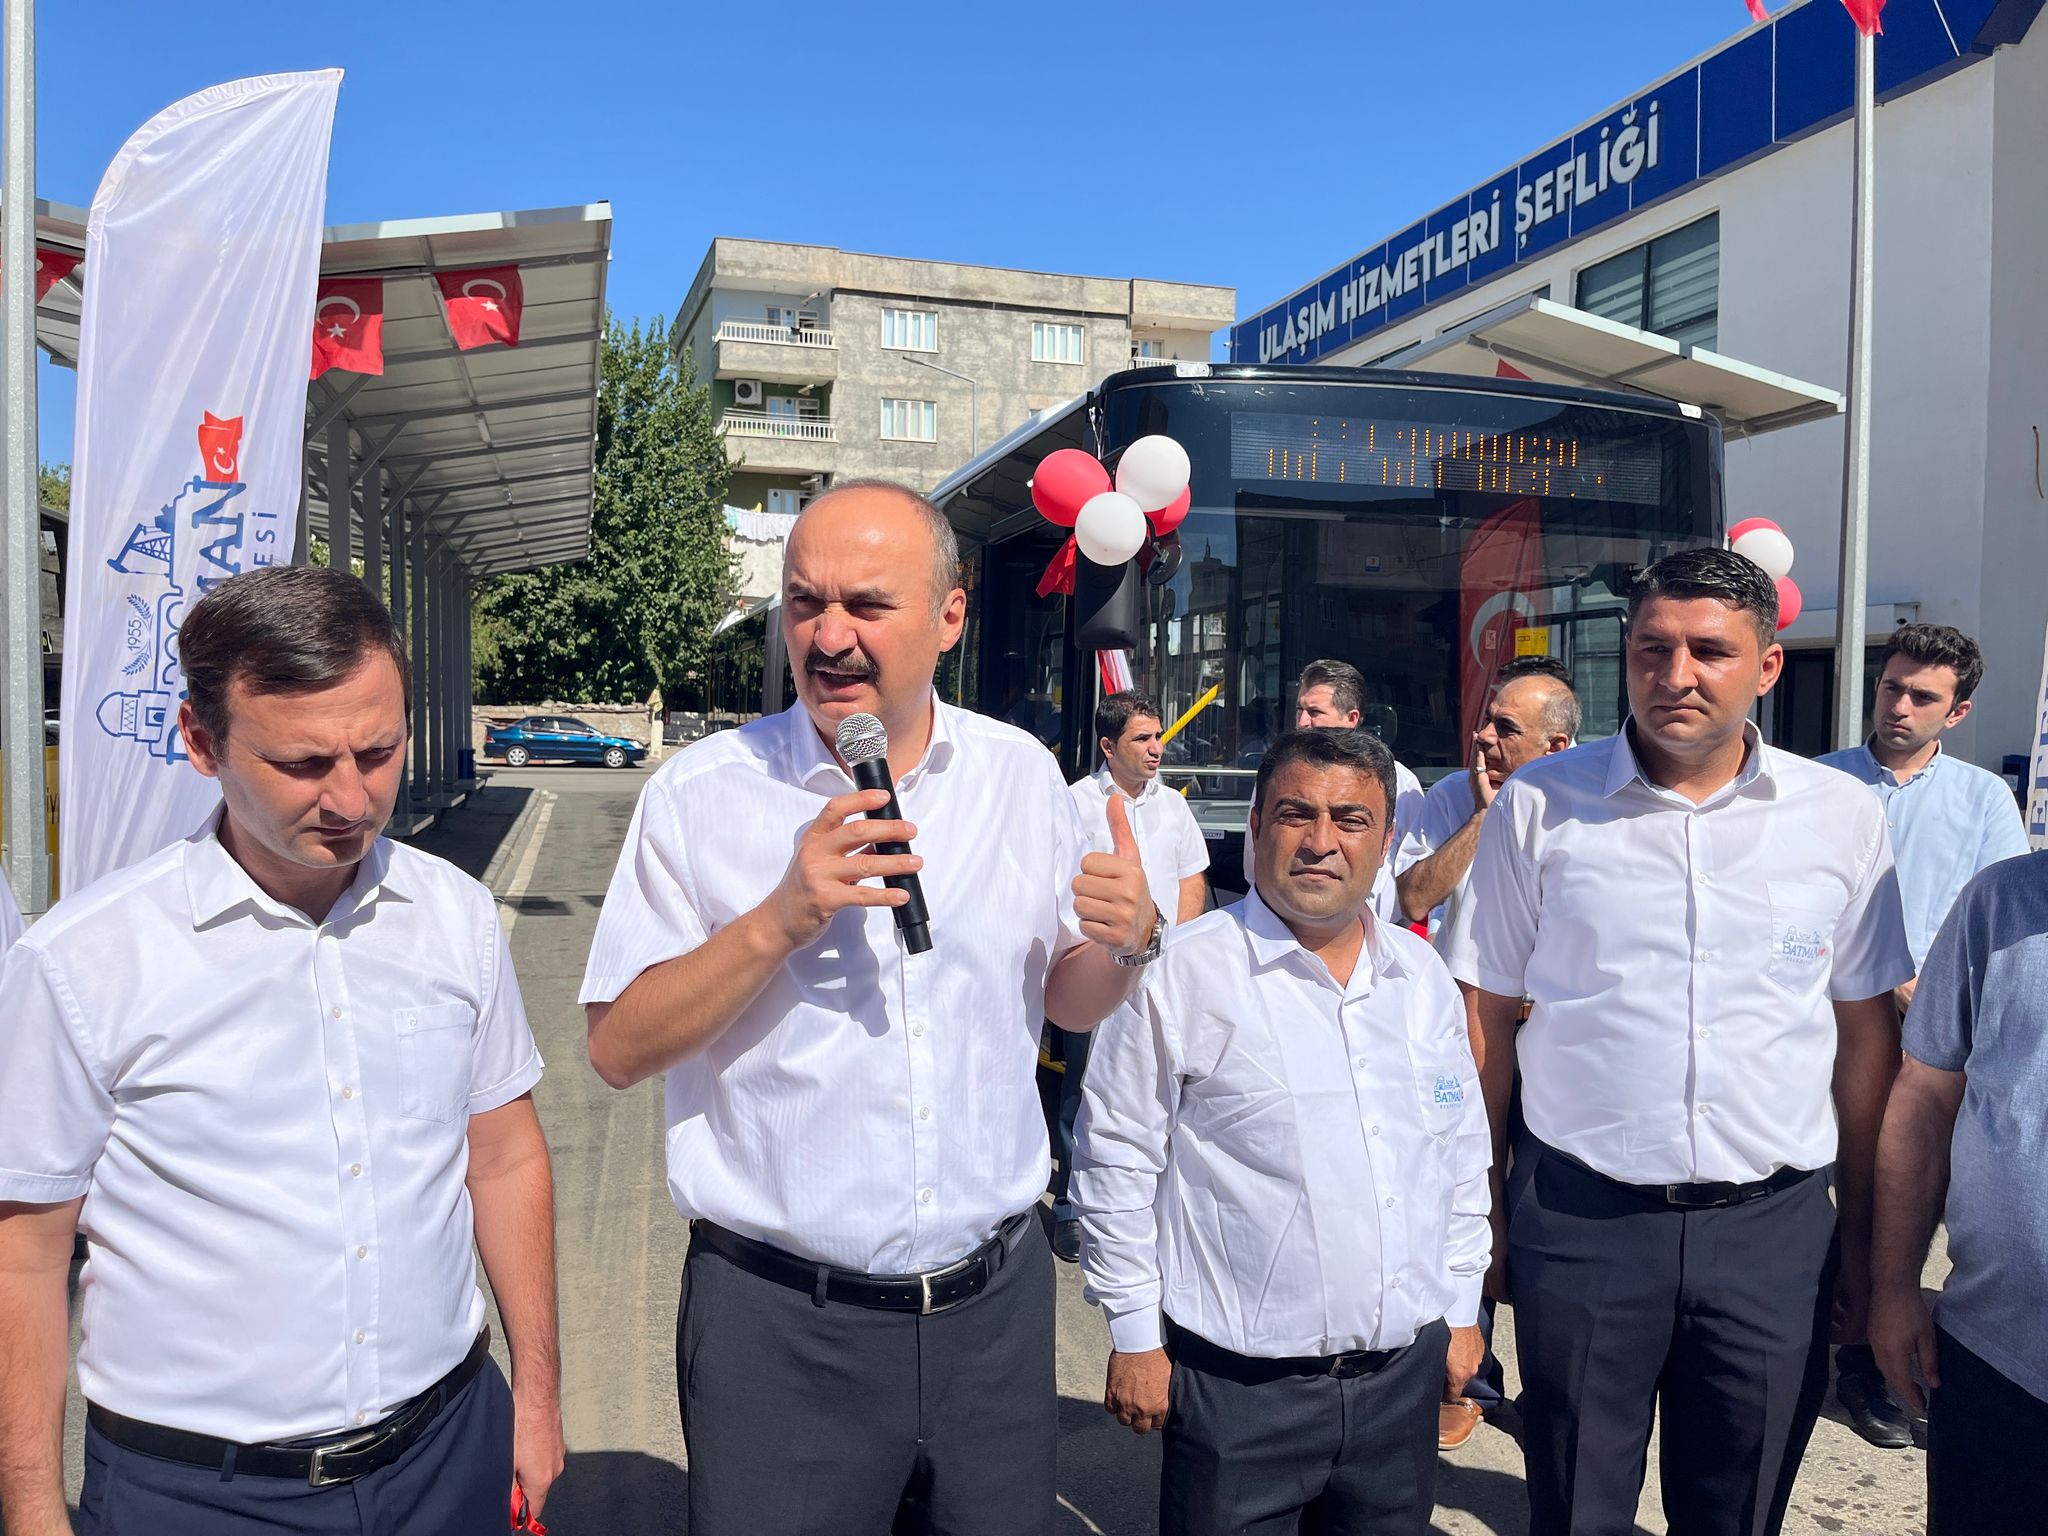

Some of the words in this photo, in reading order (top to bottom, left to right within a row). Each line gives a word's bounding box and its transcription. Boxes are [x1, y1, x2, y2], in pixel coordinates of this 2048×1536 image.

[1259, 291, 1336, 364] ULAŞIM
[1341, 189, 1501, 325] HİZMETLERİ
[1514, 100, 1659, 249] ŞEFLİĞİ
[127, 618, 143, 652] 1955
